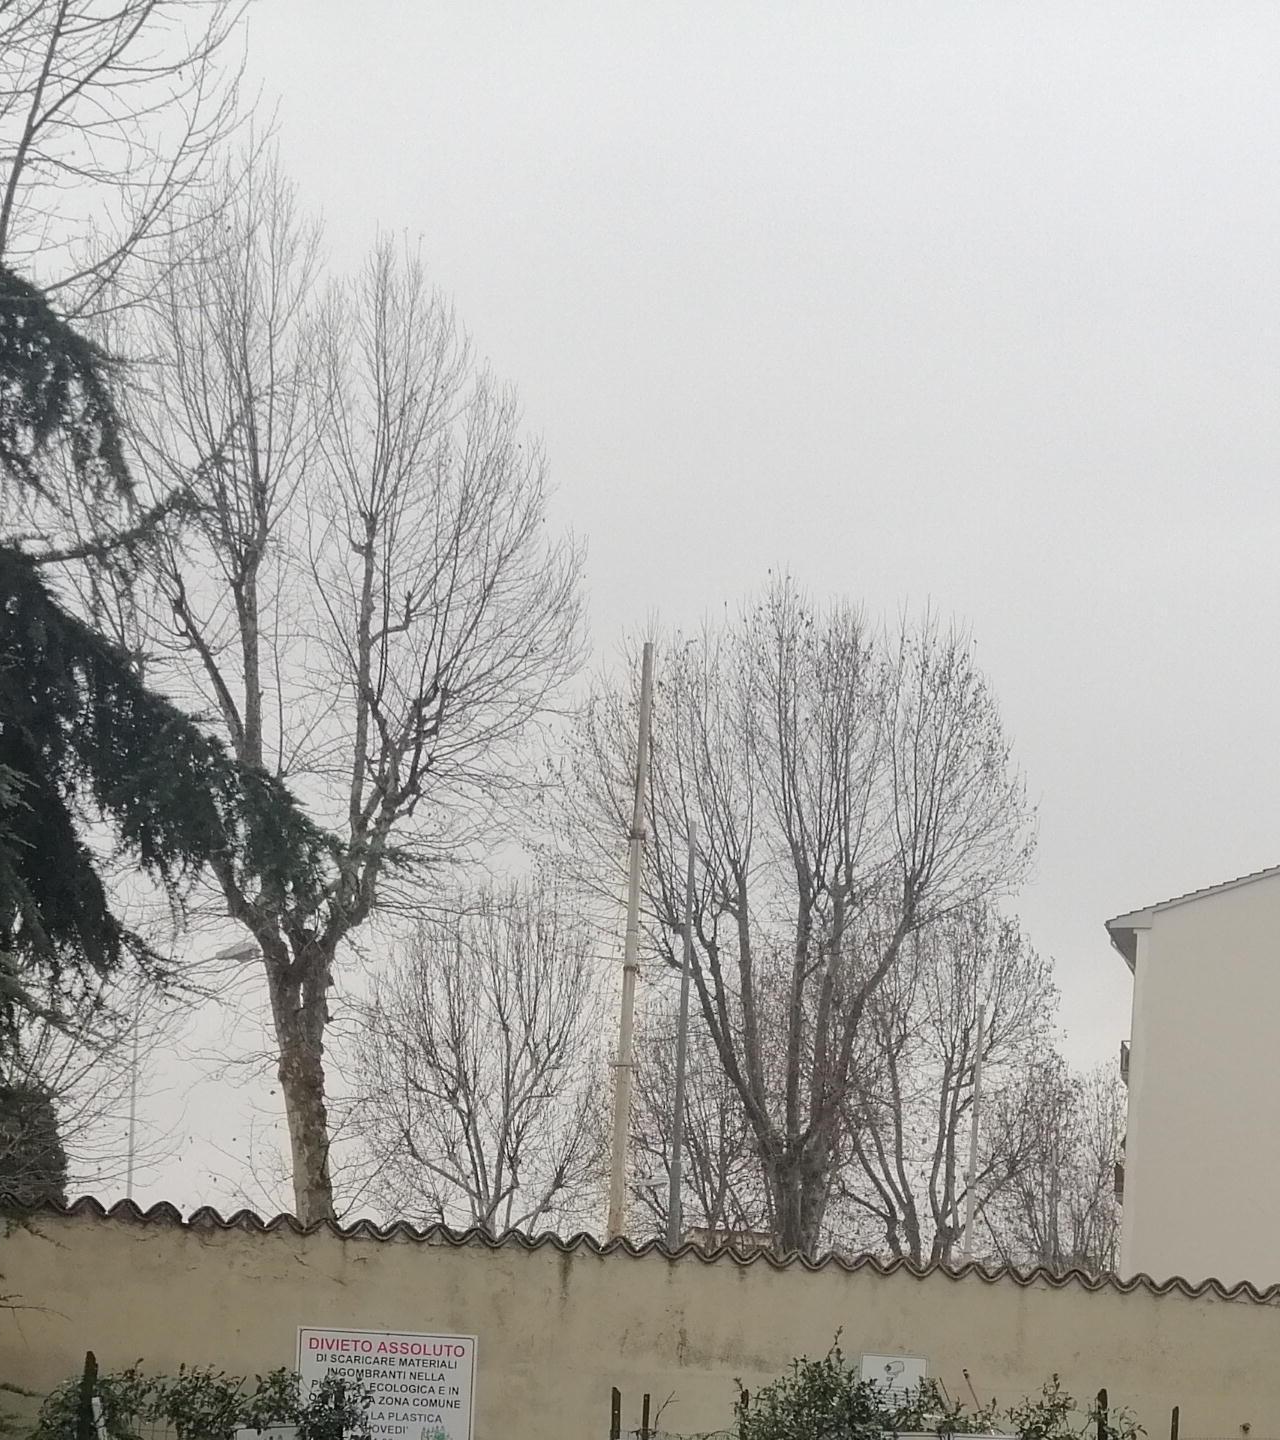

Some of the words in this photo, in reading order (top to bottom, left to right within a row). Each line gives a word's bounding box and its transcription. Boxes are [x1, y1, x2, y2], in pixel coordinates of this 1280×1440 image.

[308, 1337, 373, 1353] DIVIETO
[377, 1341, 466, 1358] ASSOLUTO
[316, 1353, 327, 1362] DI
[330, 1354, 396, 1366] SCARICARE
[398, 1357, 458, 1370] MATERIALI
[327, 1367, 407, 1380] INGOMBRANTI
[409, 1371, 446, 1382] NELLA
[369, 1382, 436, 1395] ECOLOGICA
[438, 1385, 446, 1395] E
[449, 1386, 460, 1396] IN
[378, 1396, 410, 1407] ZONA
[412, 1397, 461, 1409] COMUNE
[370, 1411, 385, 1421] LA
[387, 1412, 443, 1424] PLASTICA
